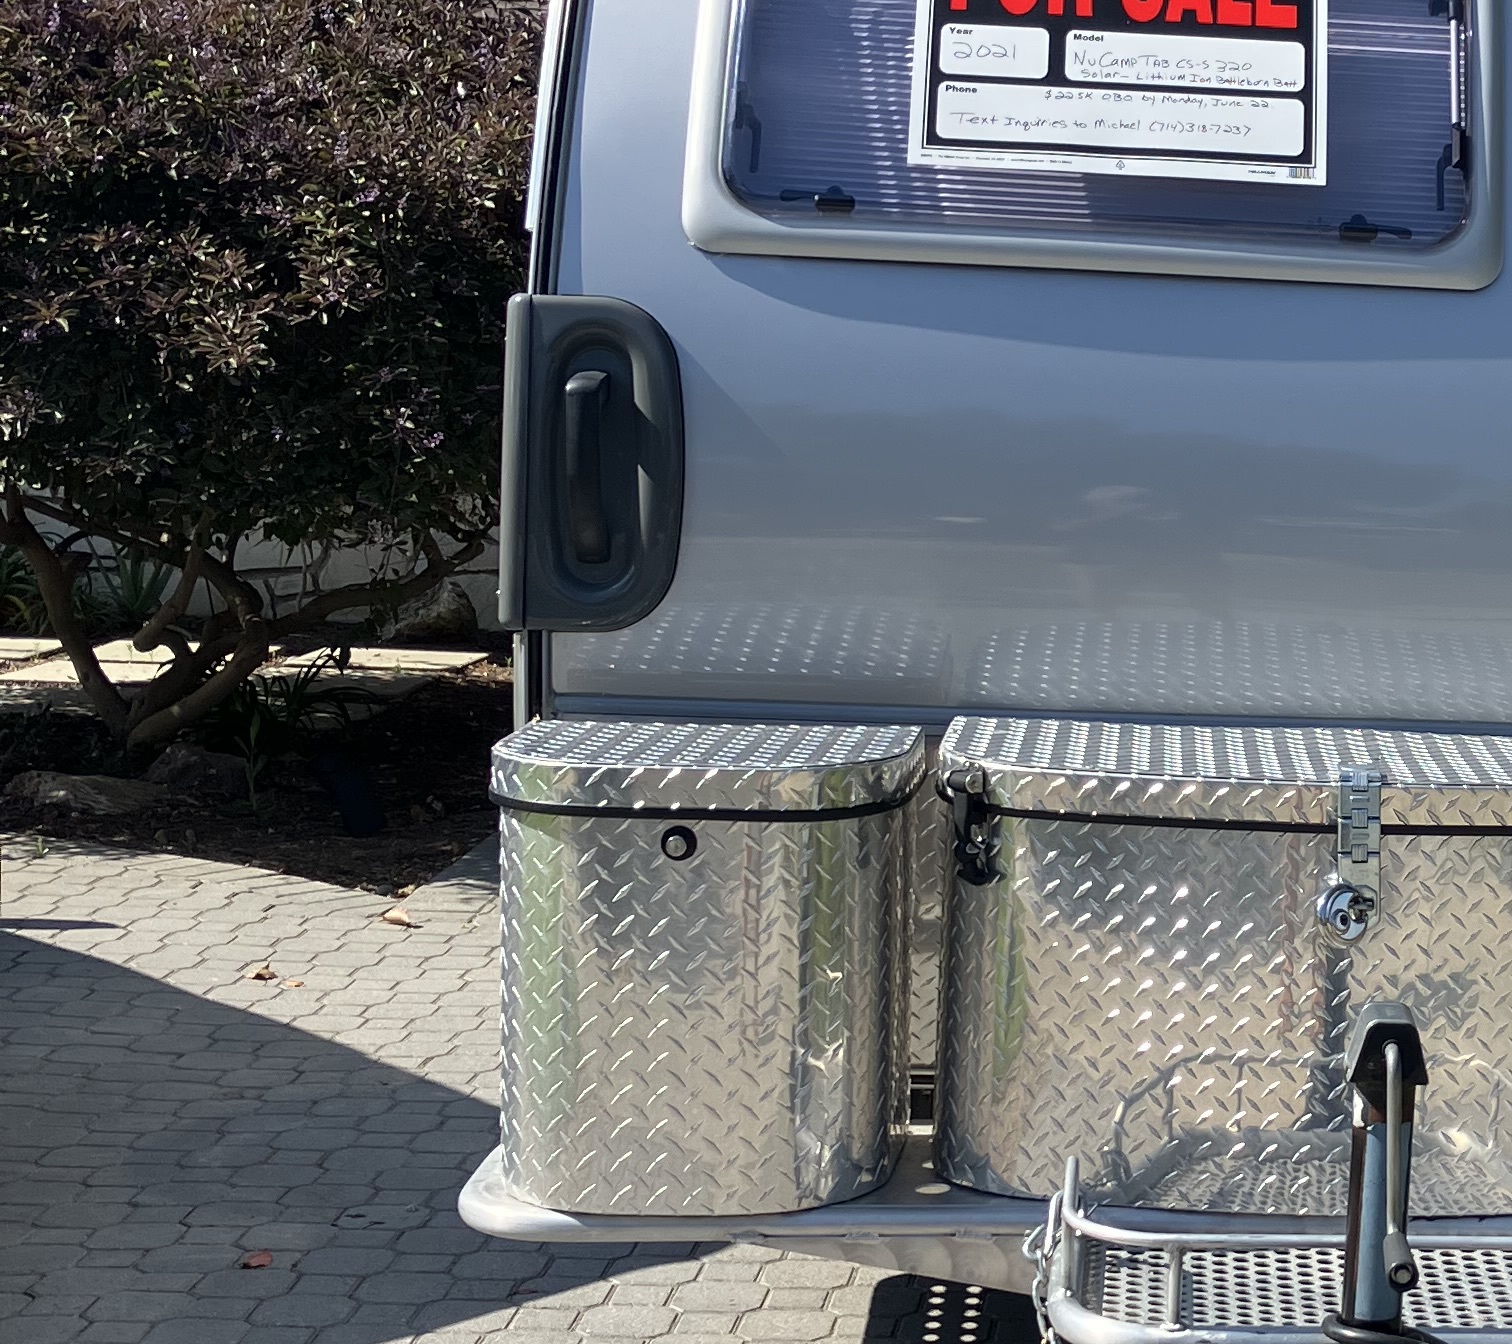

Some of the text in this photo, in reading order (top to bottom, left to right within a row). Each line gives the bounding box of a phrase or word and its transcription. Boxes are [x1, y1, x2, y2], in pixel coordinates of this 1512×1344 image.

[949, 27, 974, 35] Year
[1073, 33, 1104, 42] Model
[952, 41, 1016, 61] 2021
[1215, 60, 1253, 72] 320
[1189, 74, 1212, 85] Ion
[945, 84, 978, 94] Phone
[1101, 93, 1133, 102] OBO
[1142, 94, 1156, 106] by
[1162, 95, 1208, 109] Monday,
[1211, 98, 1244, 107] June
[949, 112, 998, 125] Text
[1073, 120, 1088, 129] to
[1094, 118, 1141, 131] Michael
